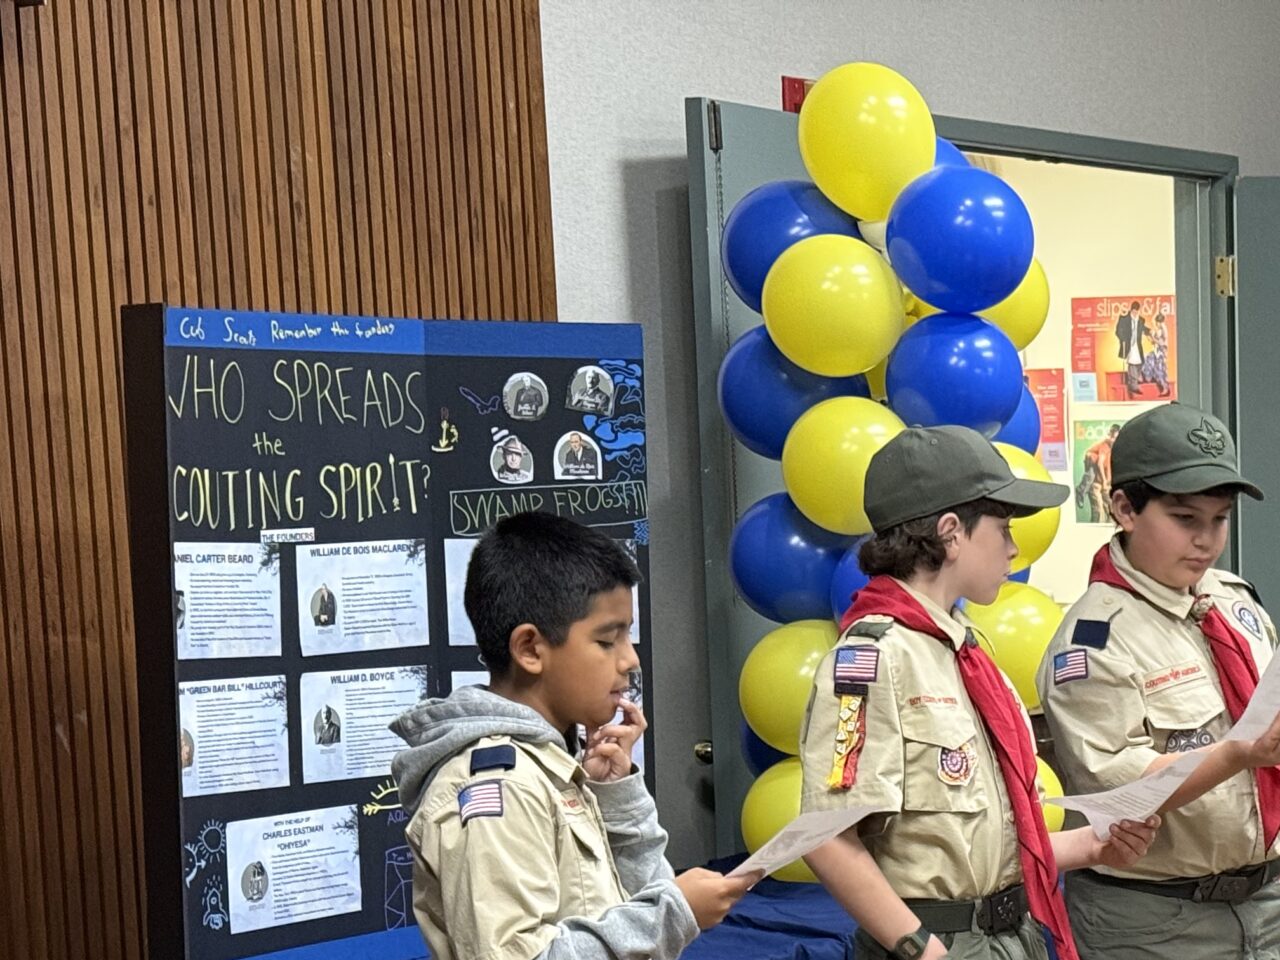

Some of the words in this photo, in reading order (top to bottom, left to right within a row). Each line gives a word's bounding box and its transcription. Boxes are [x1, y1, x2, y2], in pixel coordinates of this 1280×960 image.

[1096, 298, 1129, 320] slips
[1143, 297, 1154, 316] &
[180, 316, 206, 340] Cub
[268, 358, 425, 434] SPREADS
[252, 431, 286, 456] the
[173, 464, 304, 531] COUTING
[453, 492, 544, 534] SWAMP
[262, 534, 275, 542] THE
[276, 532, 314, 542] FOUNDERS
[195, 553, 226, 563] CARTER
[227, 554, 254, 563] BEARD
[310, 548, 341, 557] WILLIAM
[341, 547, 352, 555] DE
[353, 546, 371, 554] BOIS
[330, 674, 360, 684] WILLIAM
[361, 673, 369, 682] D.
[369, 671, 395, 681] BOYCE
[212, 685, 226, 693] BAR
[387, 809, 409, 827] AOL
[262, 828, 293, 841] CHARLES
[293, 824, 324, 836] EASTMAN
